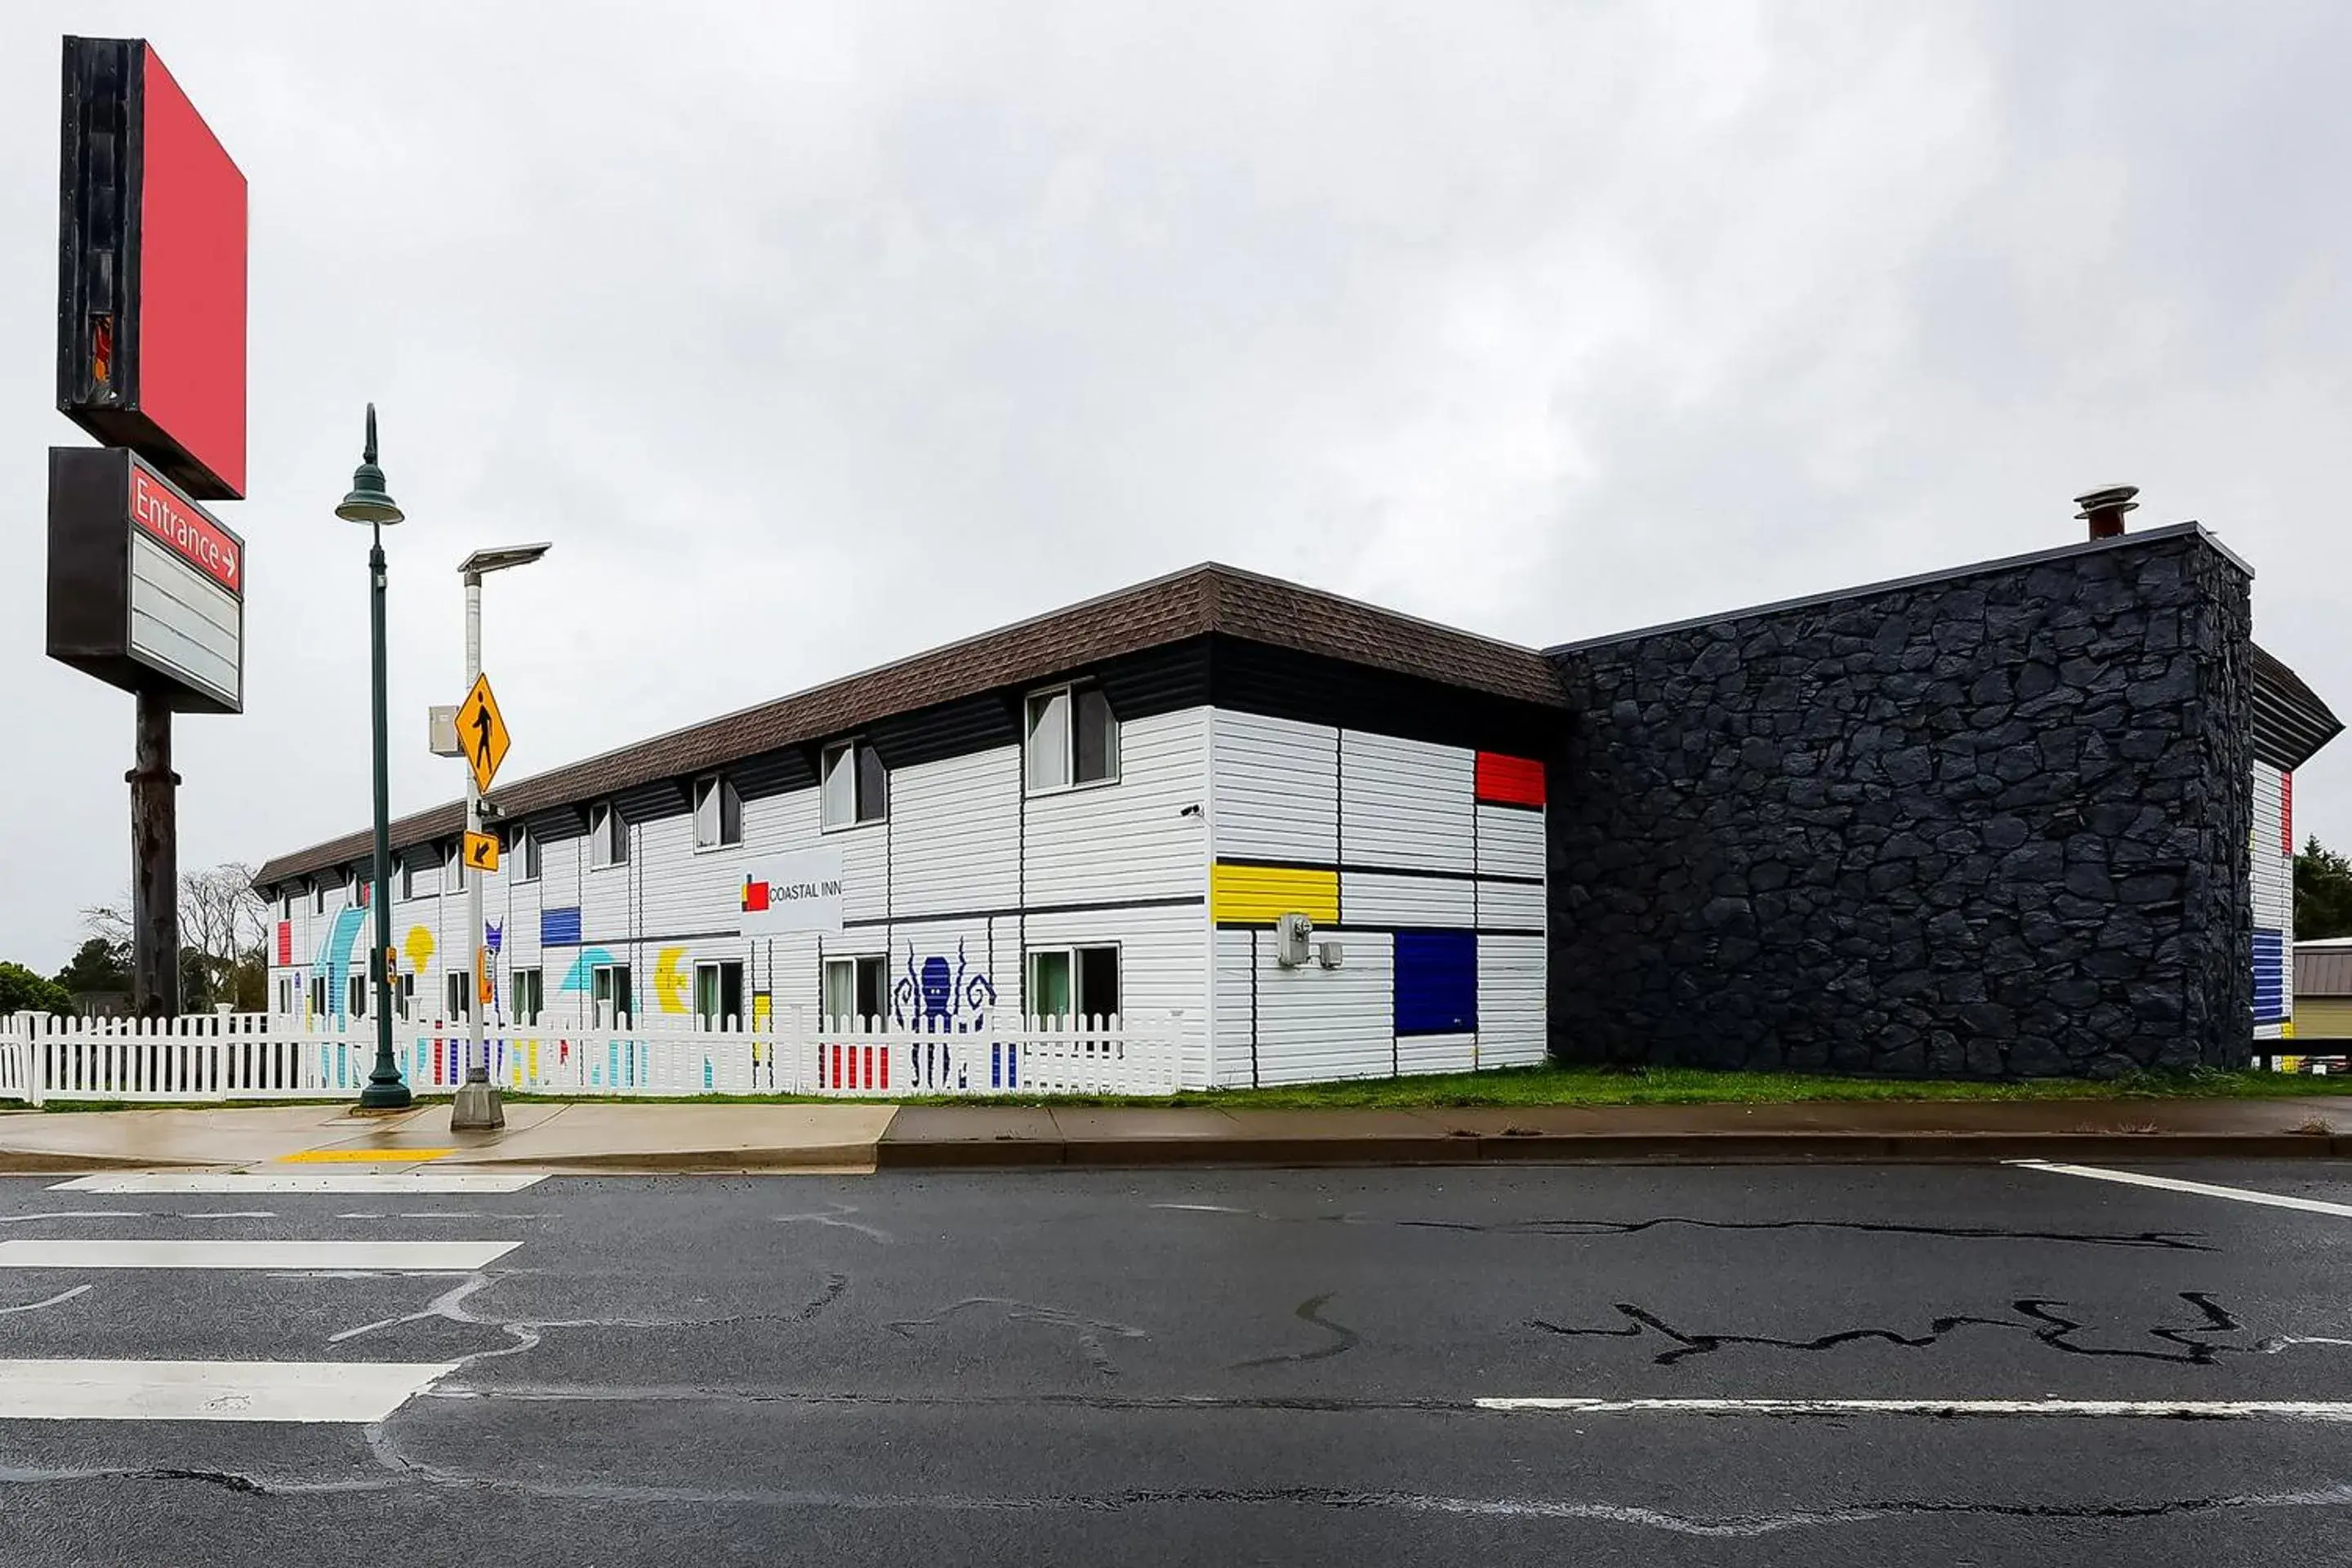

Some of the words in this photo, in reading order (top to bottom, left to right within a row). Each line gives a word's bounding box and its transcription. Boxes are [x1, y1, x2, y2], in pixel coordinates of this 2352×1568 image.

[136, 478, 219, 570] Entrance
[770, 884, 819, 902] COASTAL
[821, 880, 841, 897] INN
